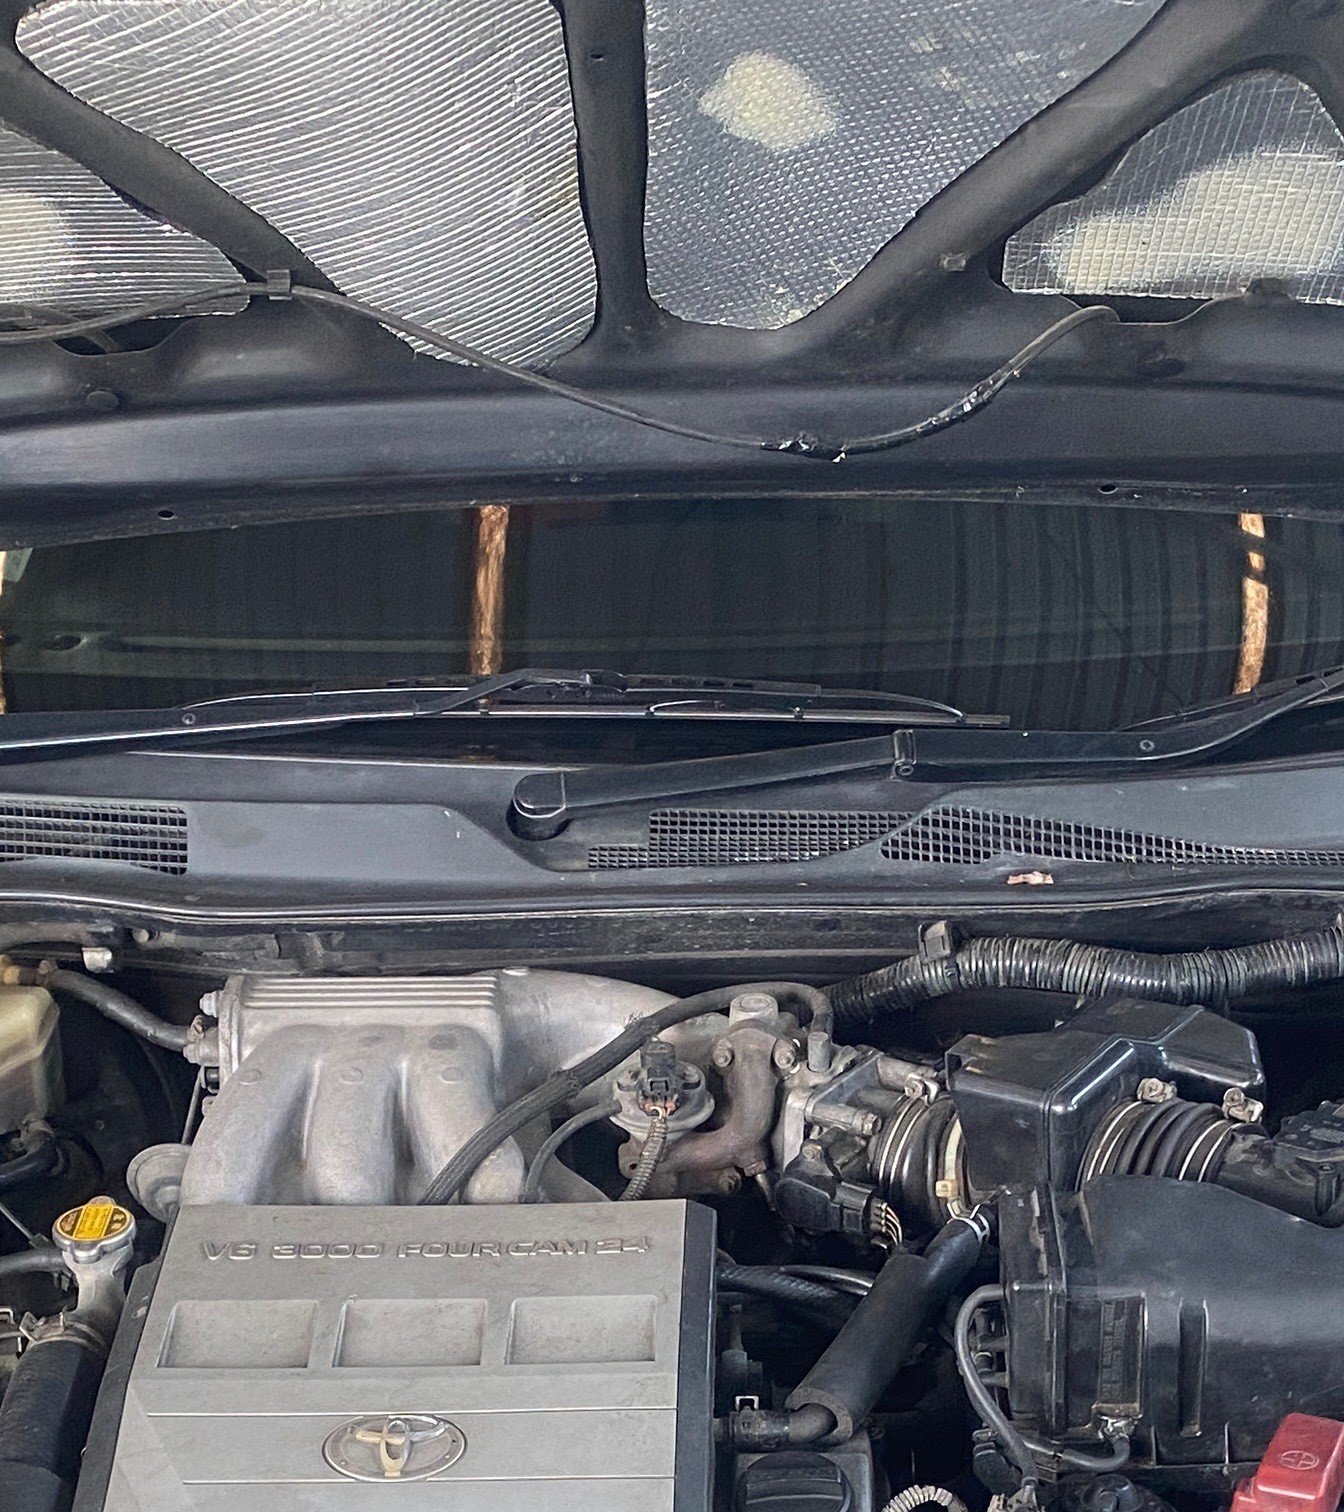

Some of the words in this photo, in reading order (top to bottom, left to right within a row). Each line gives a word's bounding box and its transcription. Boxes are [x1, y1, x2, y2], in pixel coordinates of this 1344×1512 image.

[202, 1242, 257, 1261] V6
[271, 1243, 384, 1260] 3000
[397, 1241, 501, 1258] FOUR
[507, 1239, 588, 1257] CAM
